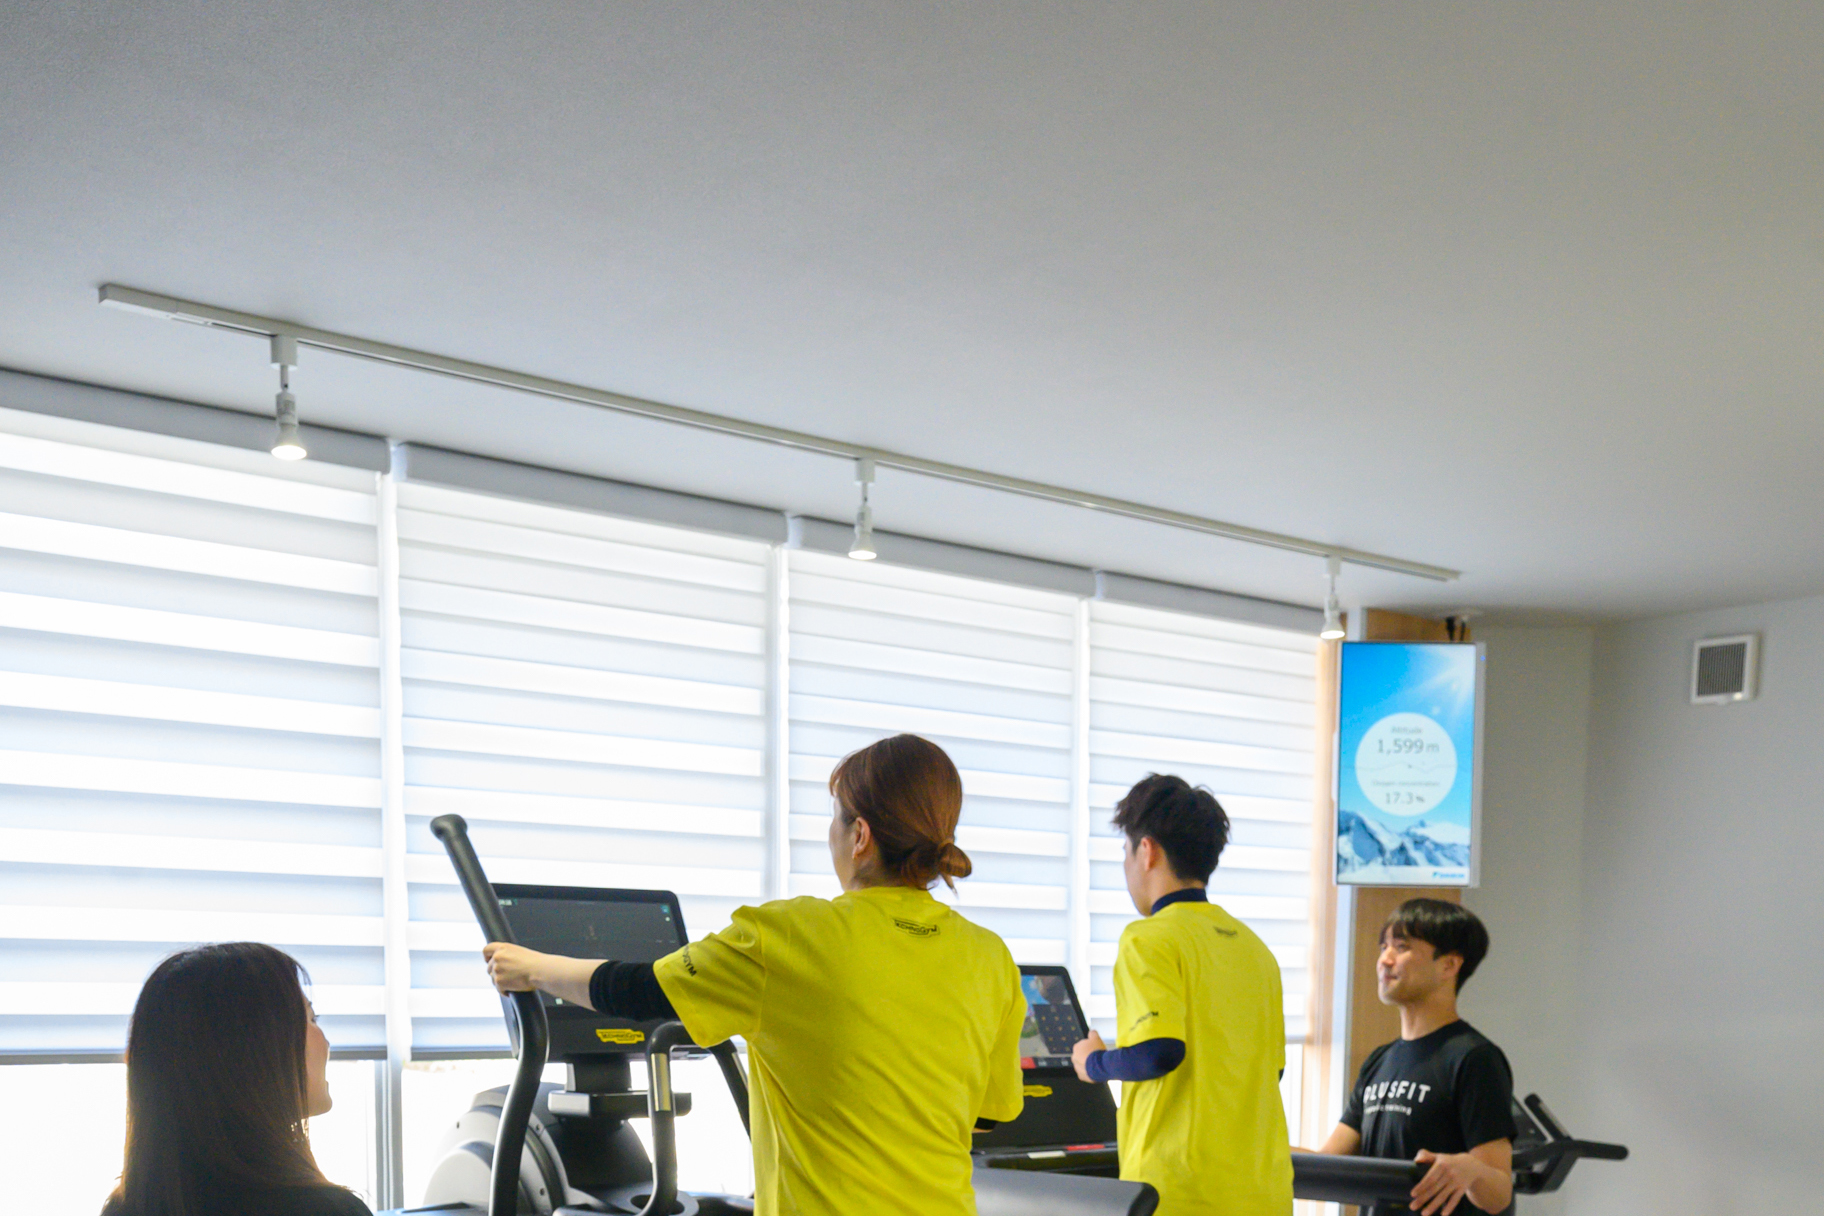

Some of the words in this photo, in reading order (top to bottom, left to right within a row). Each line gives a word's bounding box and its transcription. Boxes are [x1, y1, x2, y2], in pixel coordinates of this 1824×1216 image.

[1377, 738, 1424, 755] 1,599
[1426, 743, 1440, 753] m
[1385, 791, 1414, 804] 17.3
[1363, 1081, 1431, 1104] PLUSFIT
